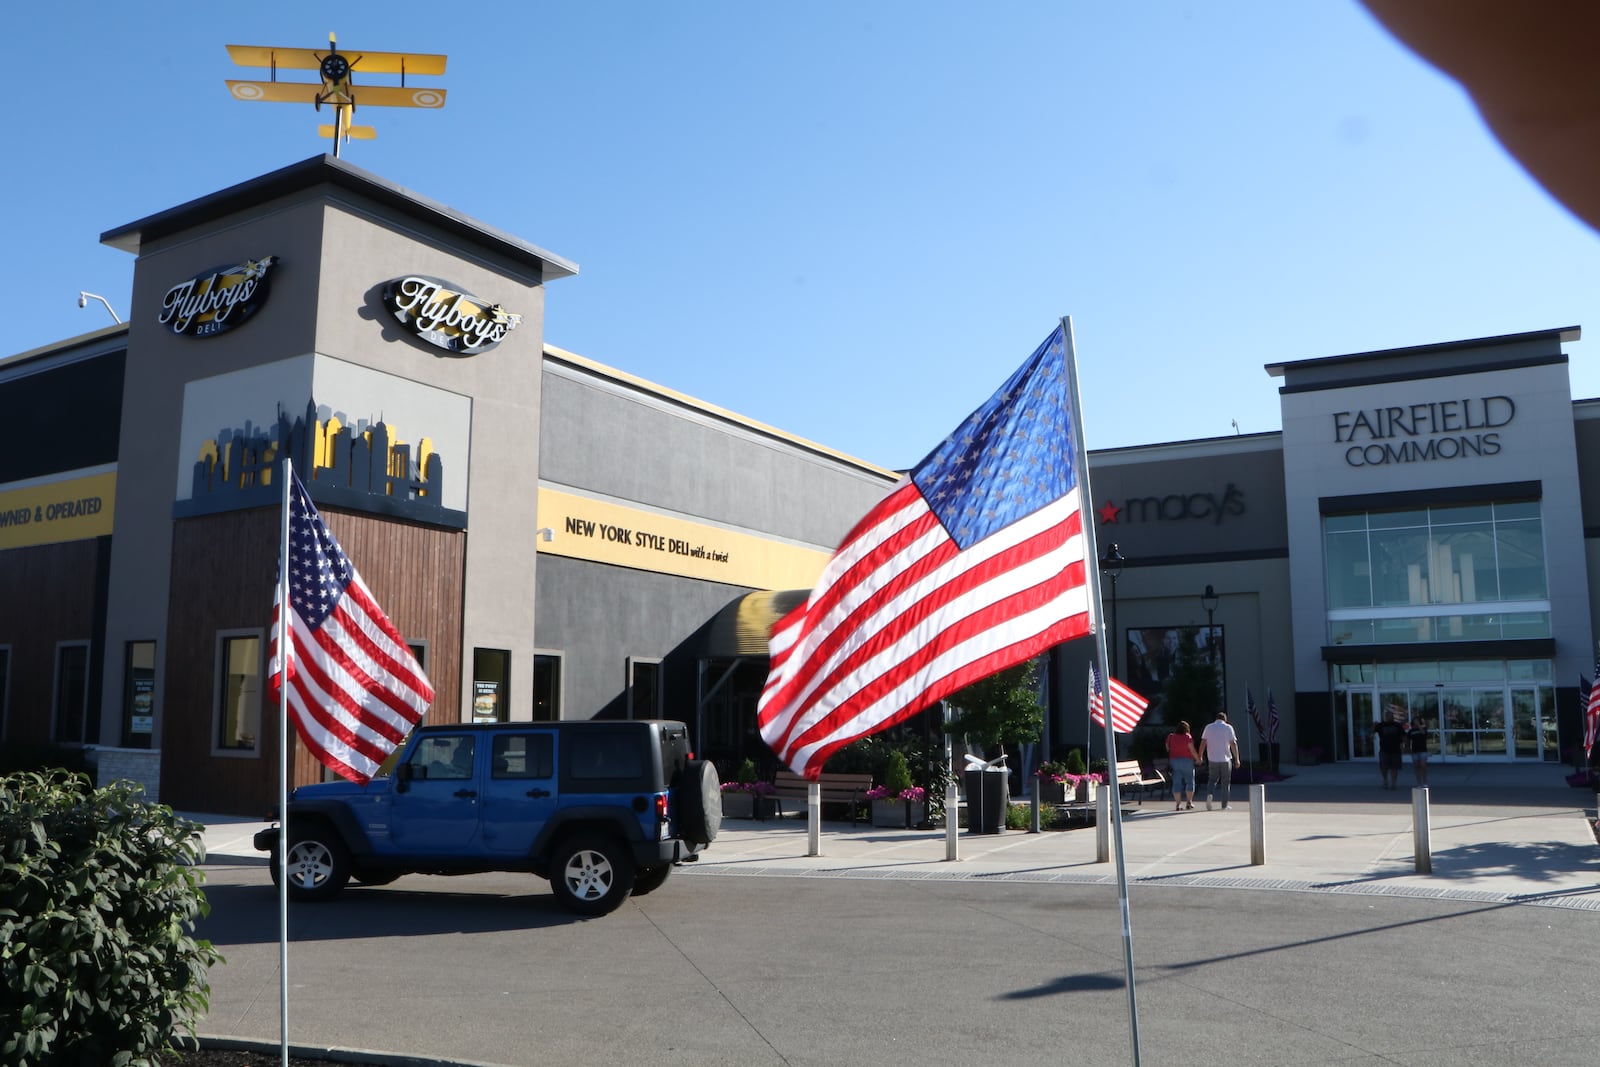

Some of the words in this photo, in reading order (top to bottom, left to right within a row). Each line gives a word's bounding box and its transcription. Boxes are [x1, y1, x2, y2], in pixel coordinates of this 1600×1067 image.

[158, 272, 258, 333] Flyboys
[395, 277, 508, 348] Flyboys
[196, 322, 223, 335] DELI
[1332, 395, 1516, 443] FAIRFIELD
[1345, 433, 1502, 467] COMMONS
[34, 504, 42, 522] &
[46, 497, 102, 521] OPERATED
[1125, 482, 1246, 526] macy's
[565, 516, 596, 538] NEW
[599, 523, 632, 545] YORK
[635, 531, 665, 551] STYLE
[668, 538, 689, 556] DELI
[690, 545, 705, 559] with
[712, 550, 728, 563] twist
